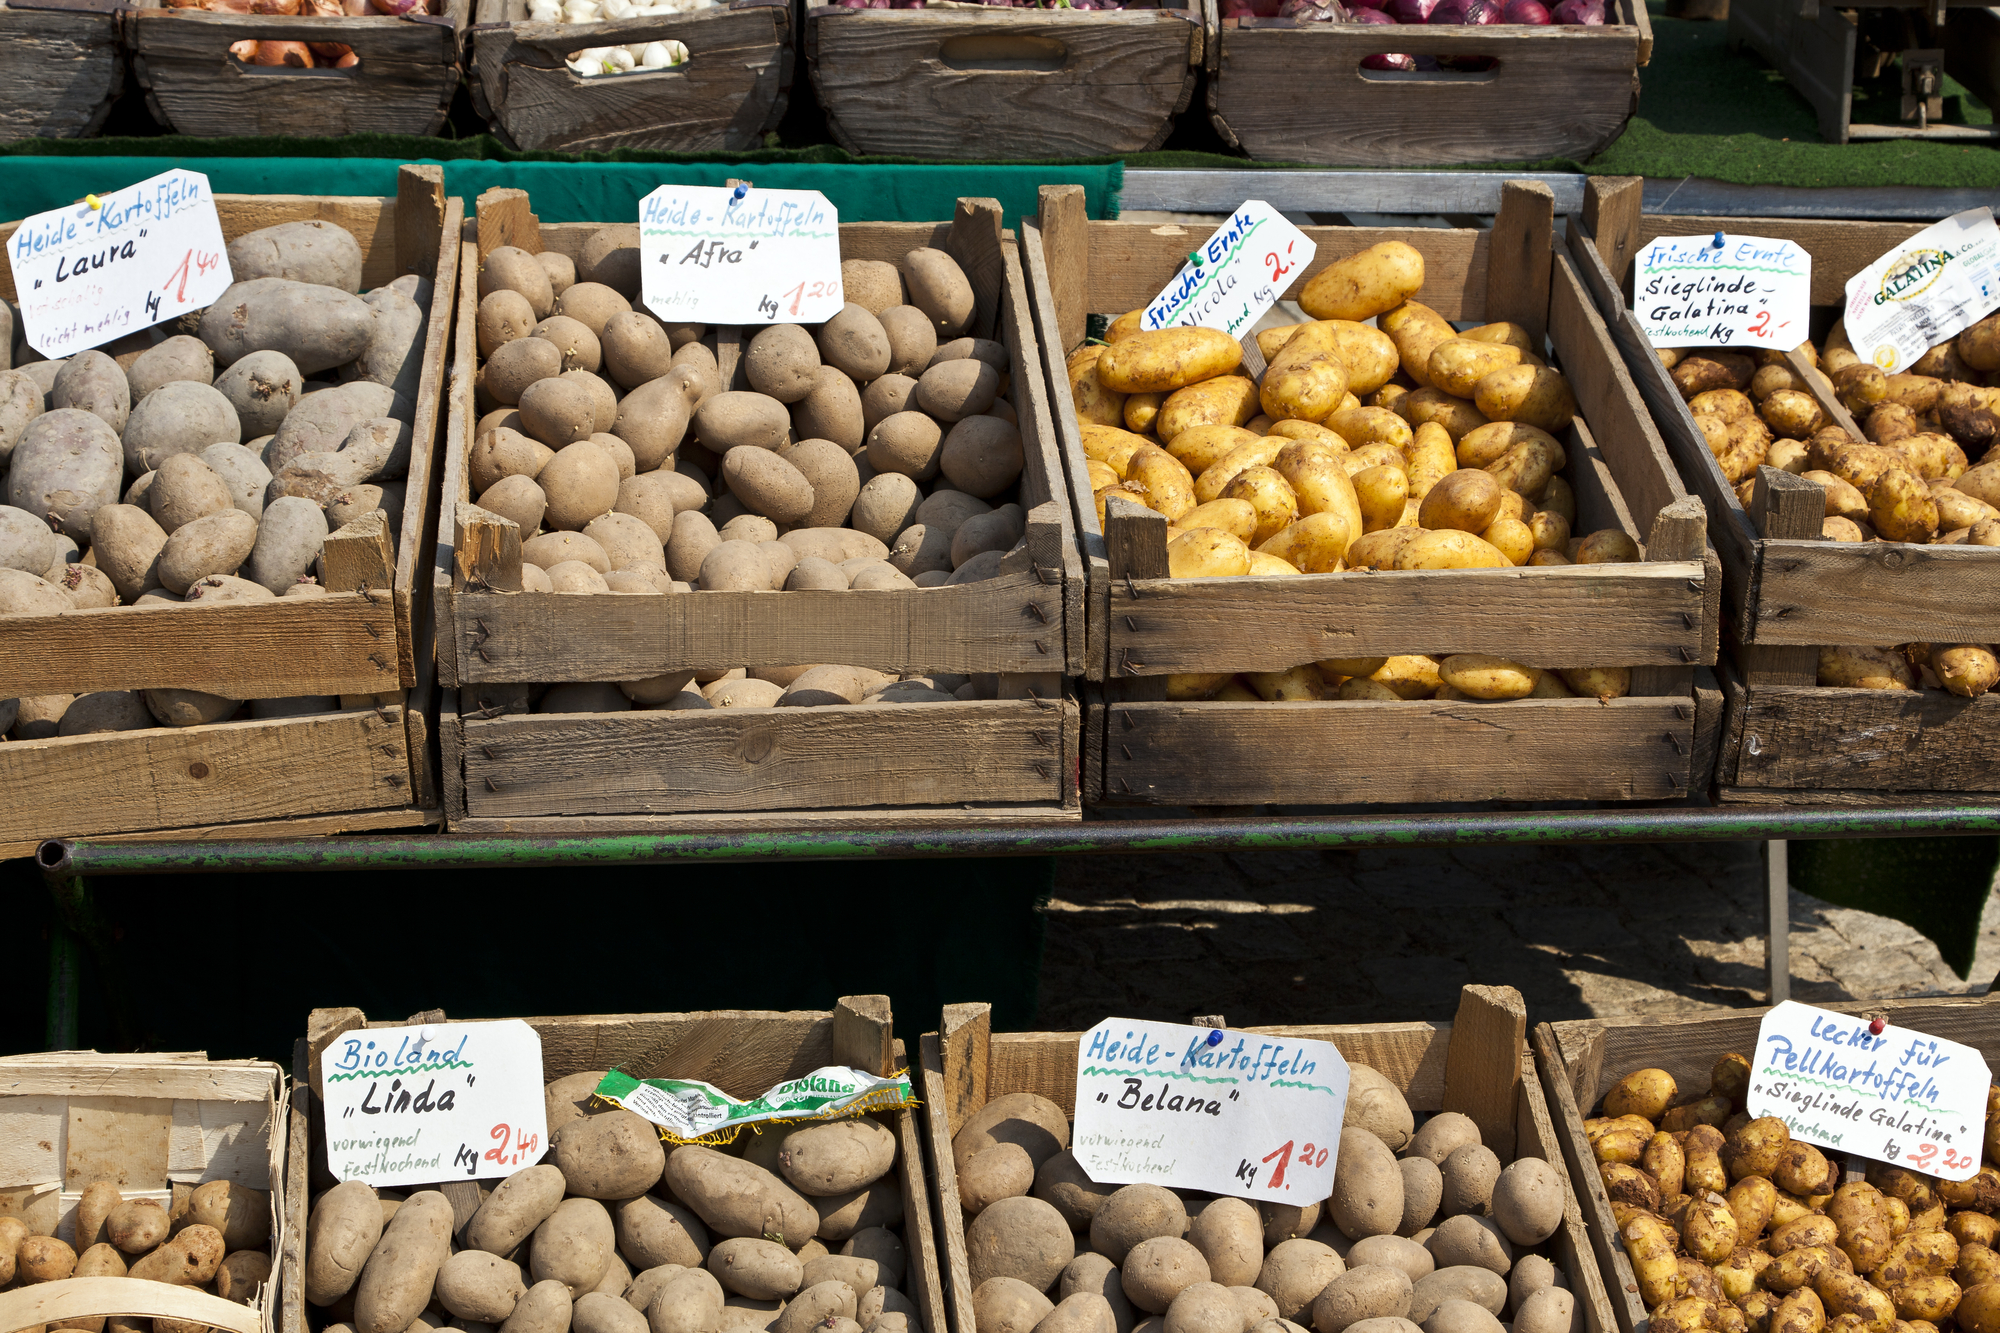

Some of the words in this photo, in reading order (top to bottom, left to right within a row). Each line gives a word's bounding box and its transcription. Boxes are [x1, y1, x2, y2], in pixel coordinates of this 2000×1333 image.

[1207, 214, 1255, 263] Ernte
[1734, 243, 1796, 267] Ernte
[1874, 250, 1955, 306] GALATINA
[651, 290, 699, 310] mehlig
[40, 322, 77, 348] leicht
[84, 306, 130, 334] mehlig
[335, 1034, 468, 1070] Bioland
[1767, 1034, 1940, 1104] Pellkartoffeln
[333, 1128, 421, 1155] vorwiegend
[1080, 1129, 1165, 1155] vorwiegend
